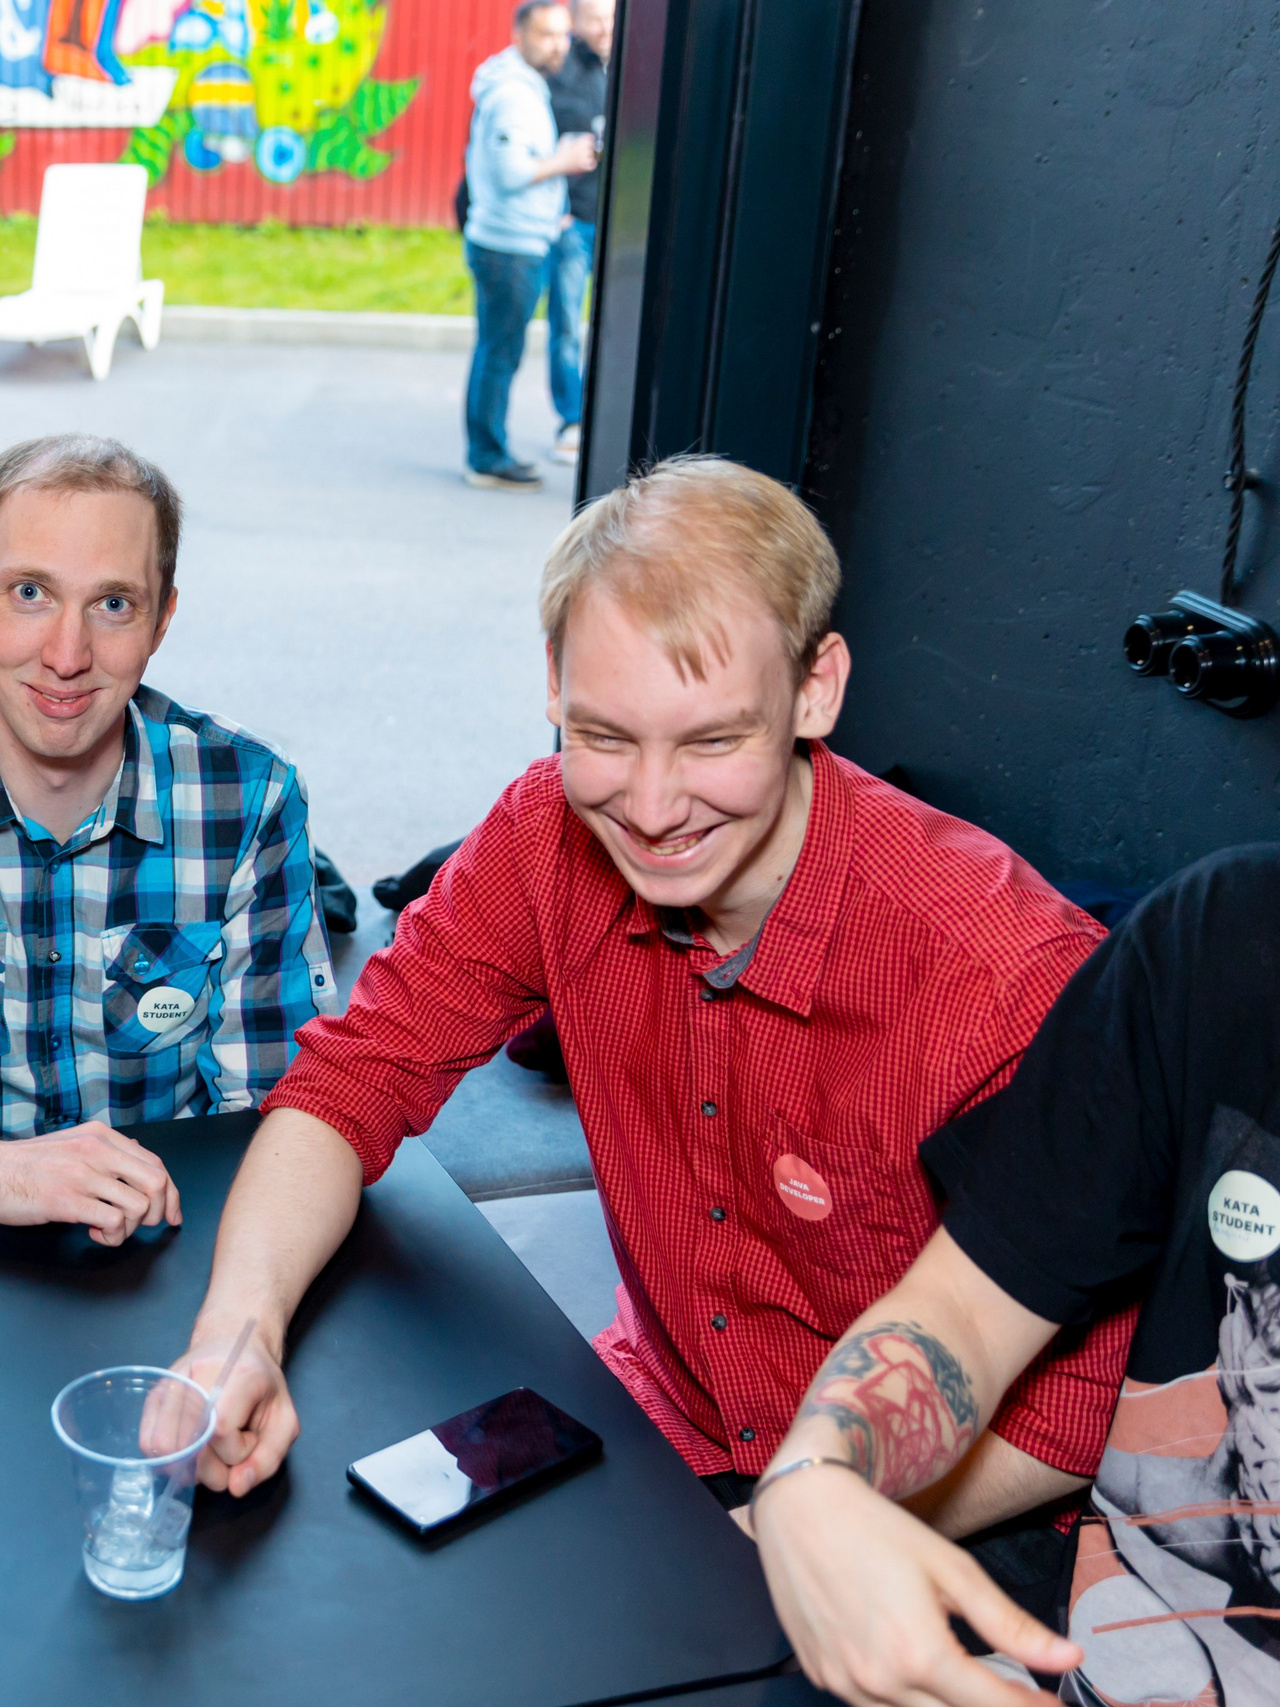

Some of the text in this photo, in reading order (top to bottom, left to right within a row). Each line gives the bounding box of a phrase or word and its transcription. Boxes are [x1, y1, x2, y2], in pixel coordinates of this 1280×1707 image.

[780, 1182, 825, 1205] DEVELOPER
[1223, 1197, 1260, 1217] KATA
[1212, 1210, 1276, 1236] STUDENT
